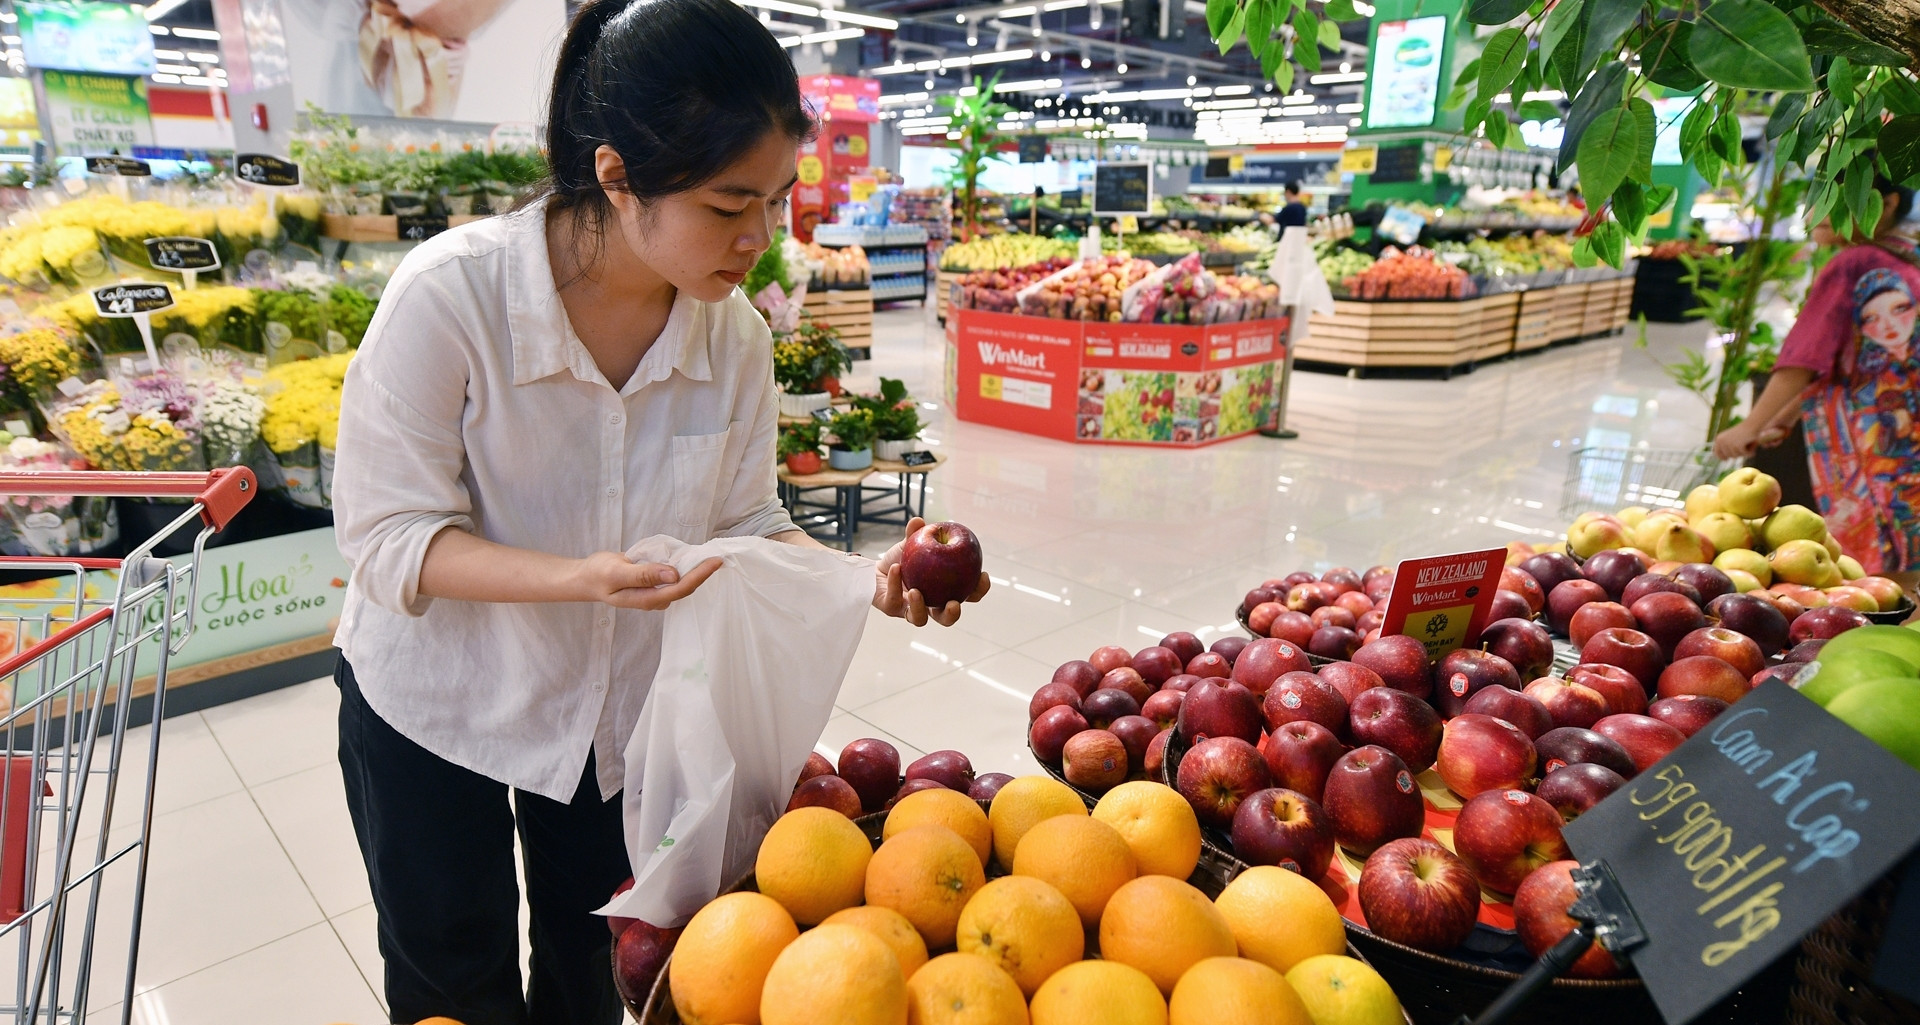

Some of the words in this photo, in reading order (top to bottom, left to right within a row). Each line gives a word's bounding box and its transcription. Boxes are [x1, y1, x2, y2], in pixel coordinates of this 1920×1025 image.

[977, 340, 1046, 371] WinMart
[201, 560, 295, 614] Hoa
[1416, 565, 1443, 584] NEW
[1441, 559, 1488, 580] ZEALAND
[1412, 588, 1457, 606] WinMart
[207, 607, 266, 631] CUỘC
[274, 595, 327, 616] SỐNG
[1440, 636, 1456, 646] BAY
[1710, 707, 1775, 776] Cam
